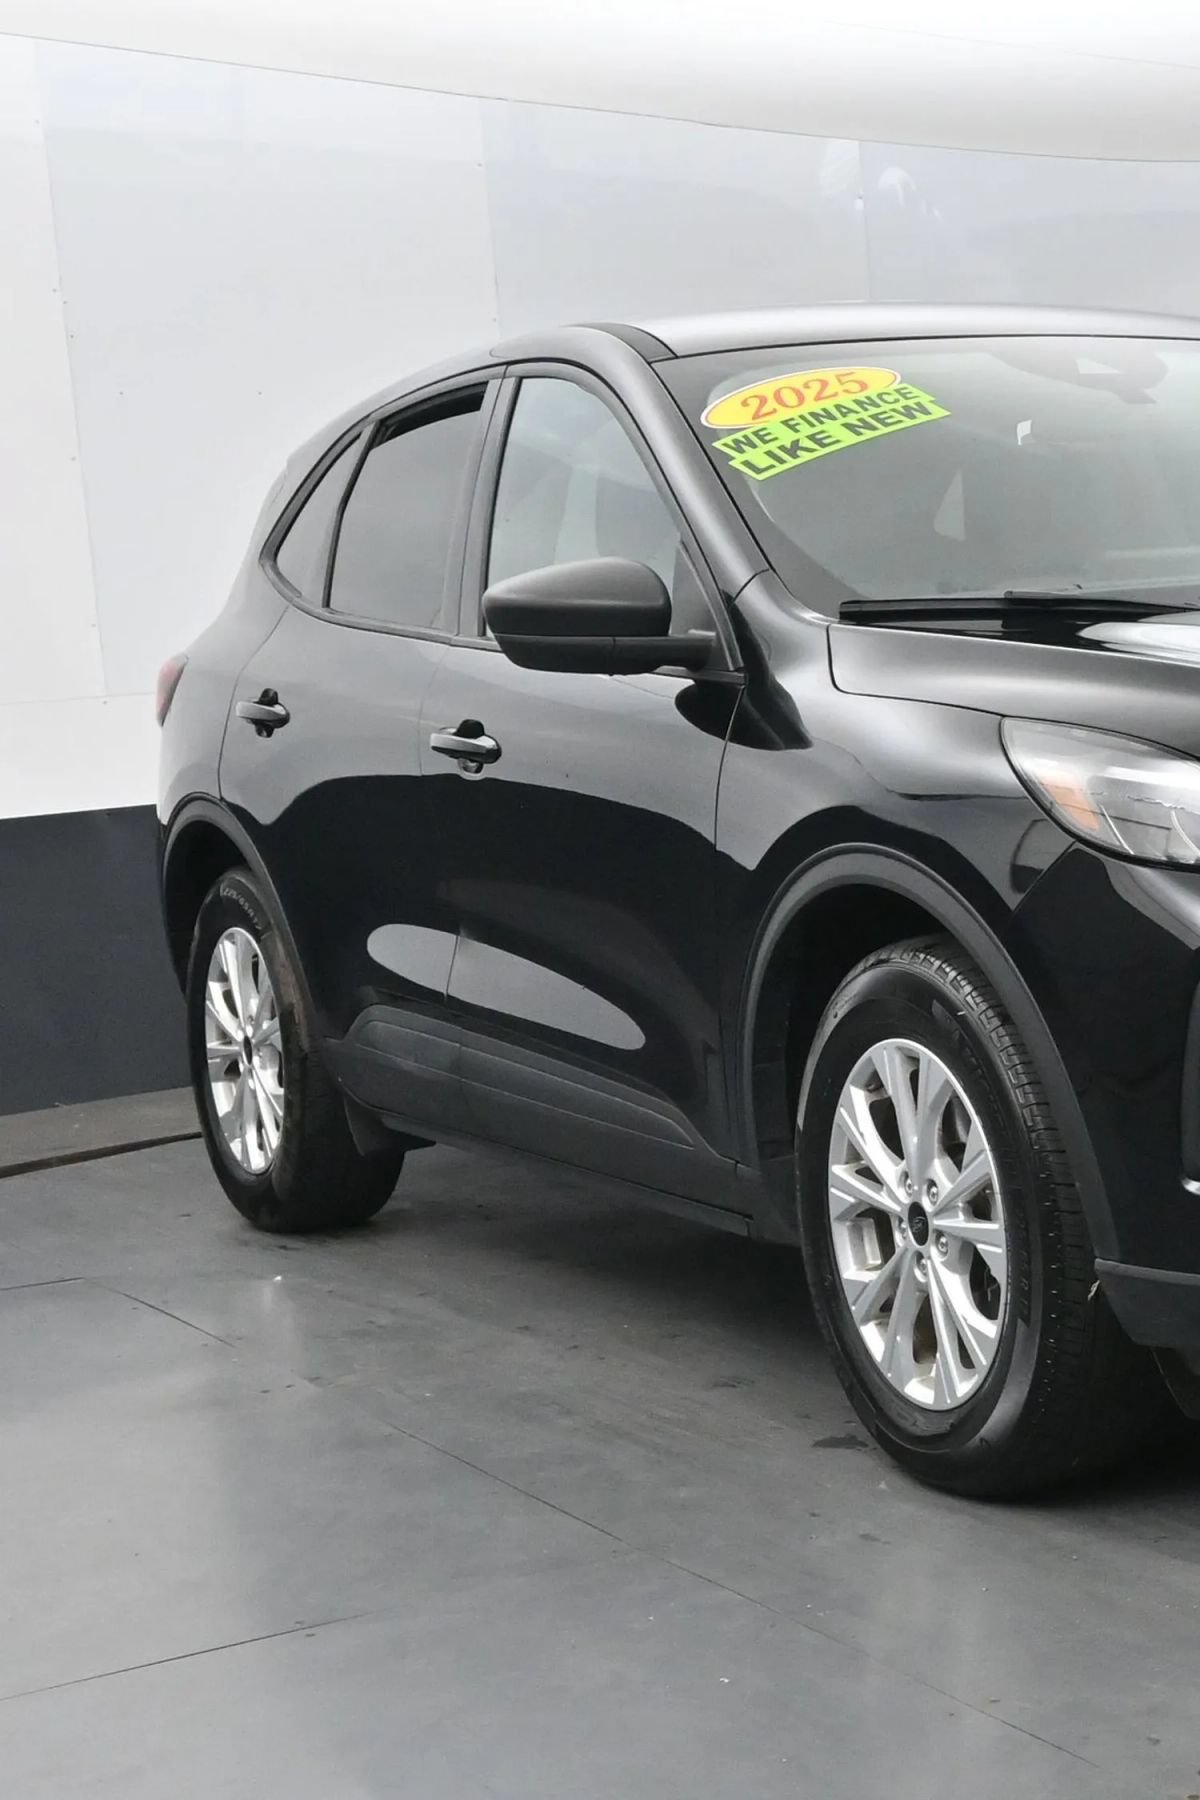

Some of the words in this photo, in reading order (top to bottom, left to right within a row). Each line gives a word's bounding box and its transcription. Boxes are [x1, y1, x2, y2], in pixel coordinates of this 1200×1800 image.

[721, 427, 779, 455] WE
[780, 386, 921, 435] FINANCE
[740, 371, 869, 421] 2025
[740, 430, 841, 475] LIKE
[840, 401, 933, 437] NEW
